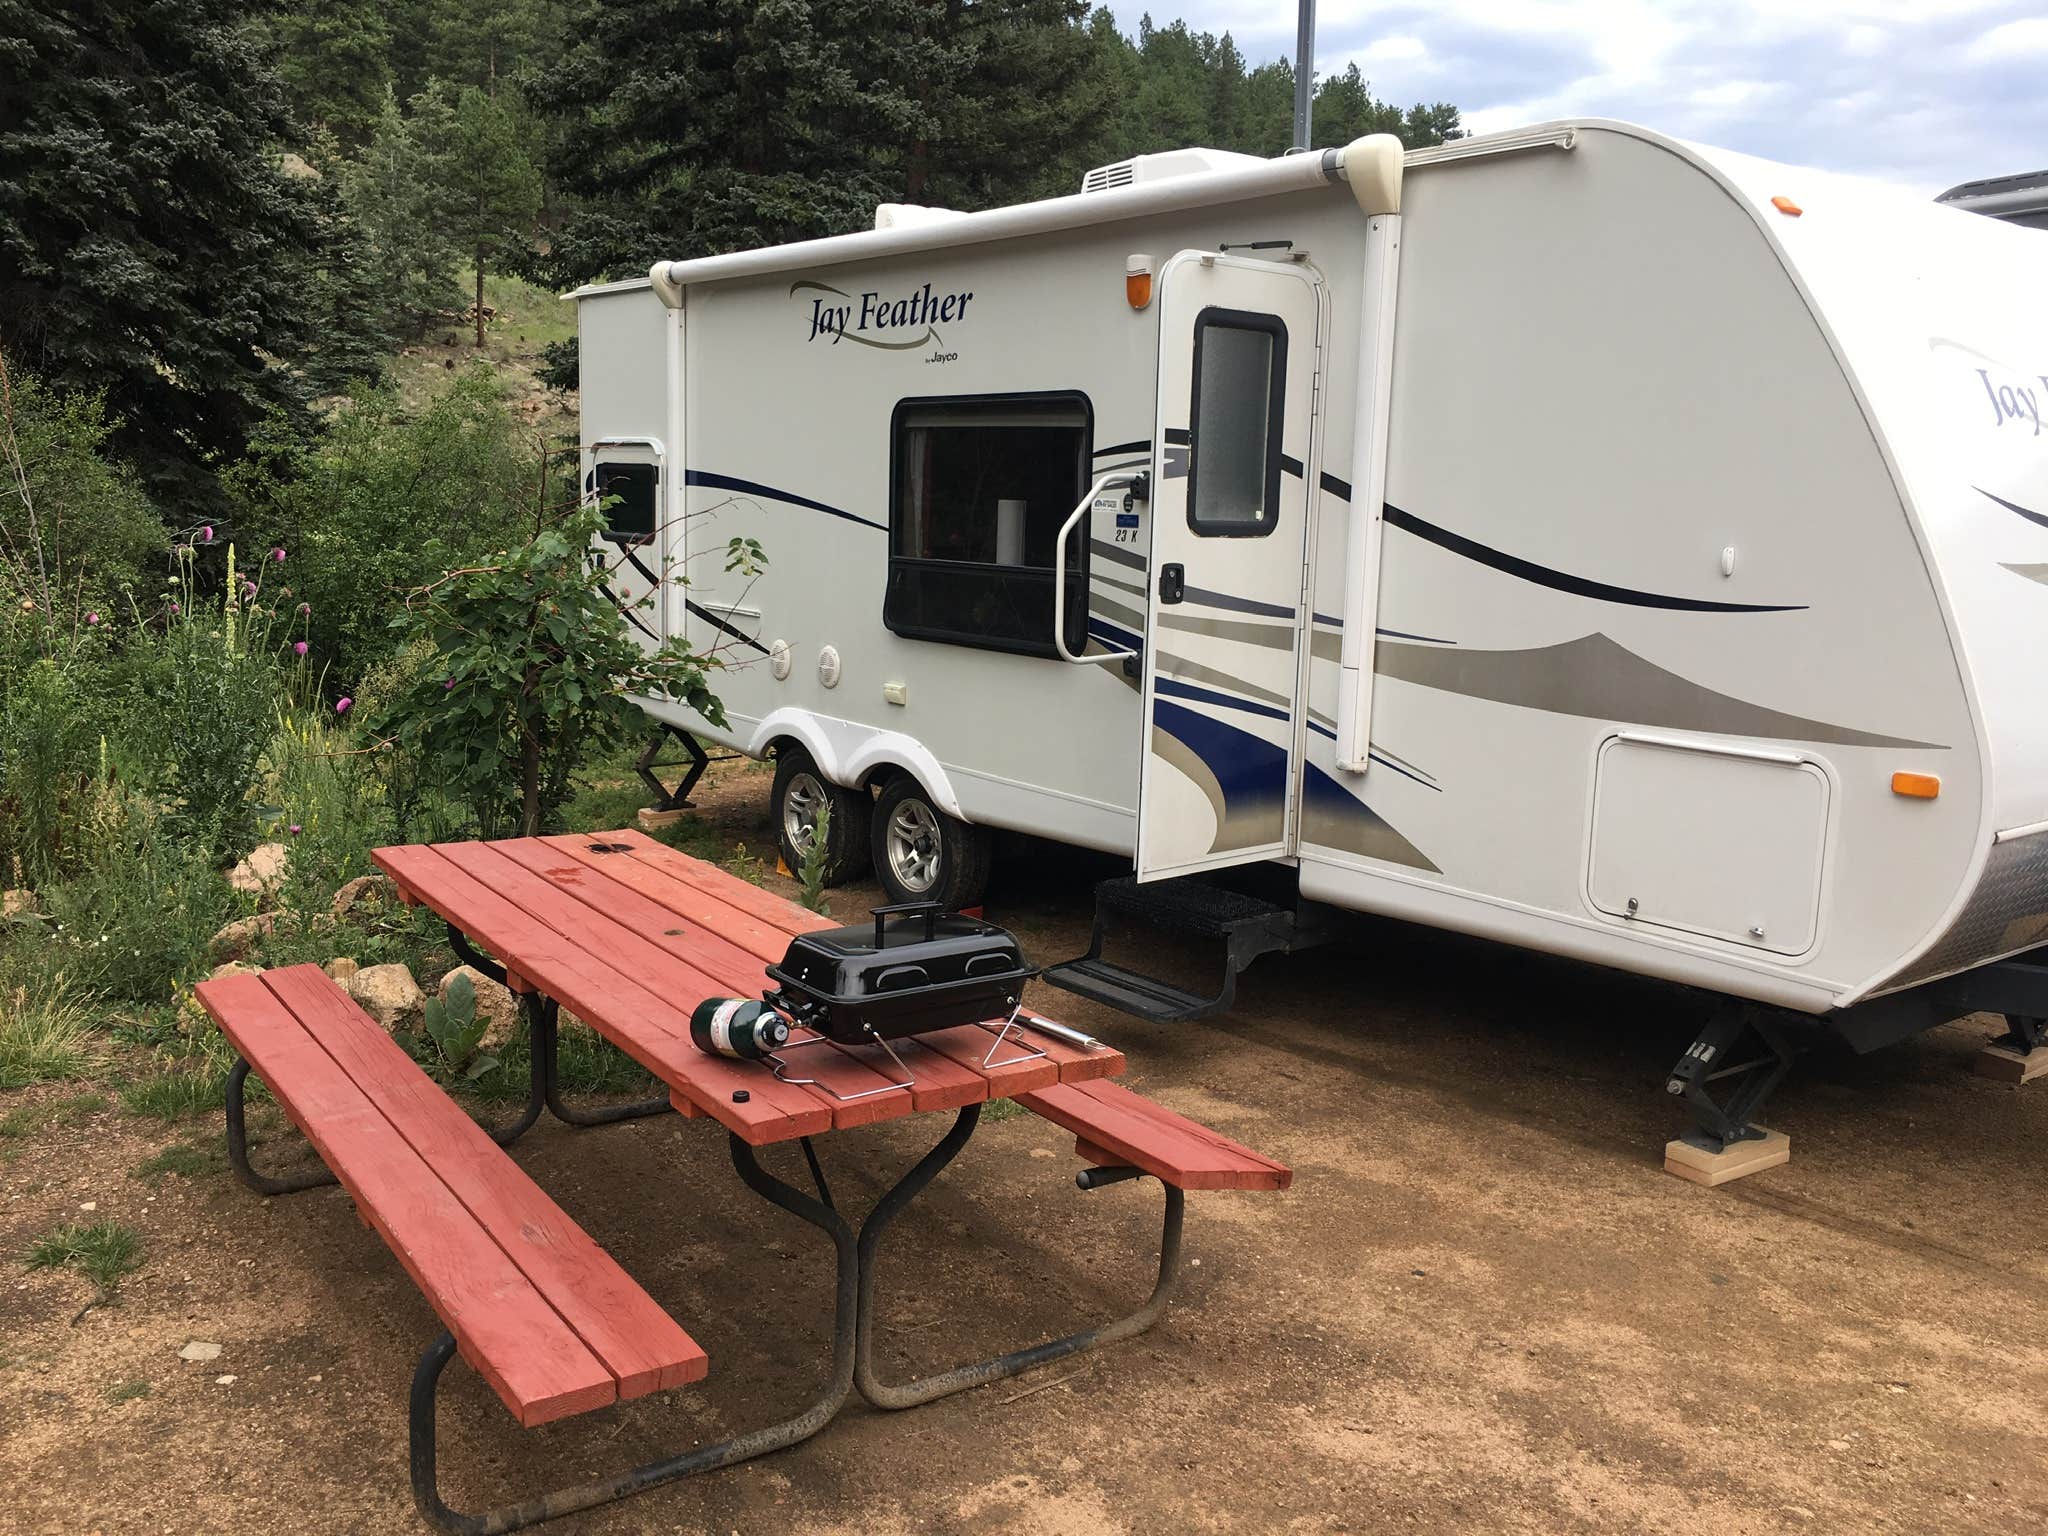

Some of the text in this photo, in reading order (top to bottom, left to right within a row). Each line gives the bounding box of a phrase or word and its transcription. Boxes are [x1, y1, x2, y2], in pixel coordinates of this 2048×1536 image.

[809, 283, 973, 344] Jay Feather
[931, 351, 958, 364] Jayco
[1975, 368, 2040, 436] Jay
[1115, 529, 1138, 543] 23 K
